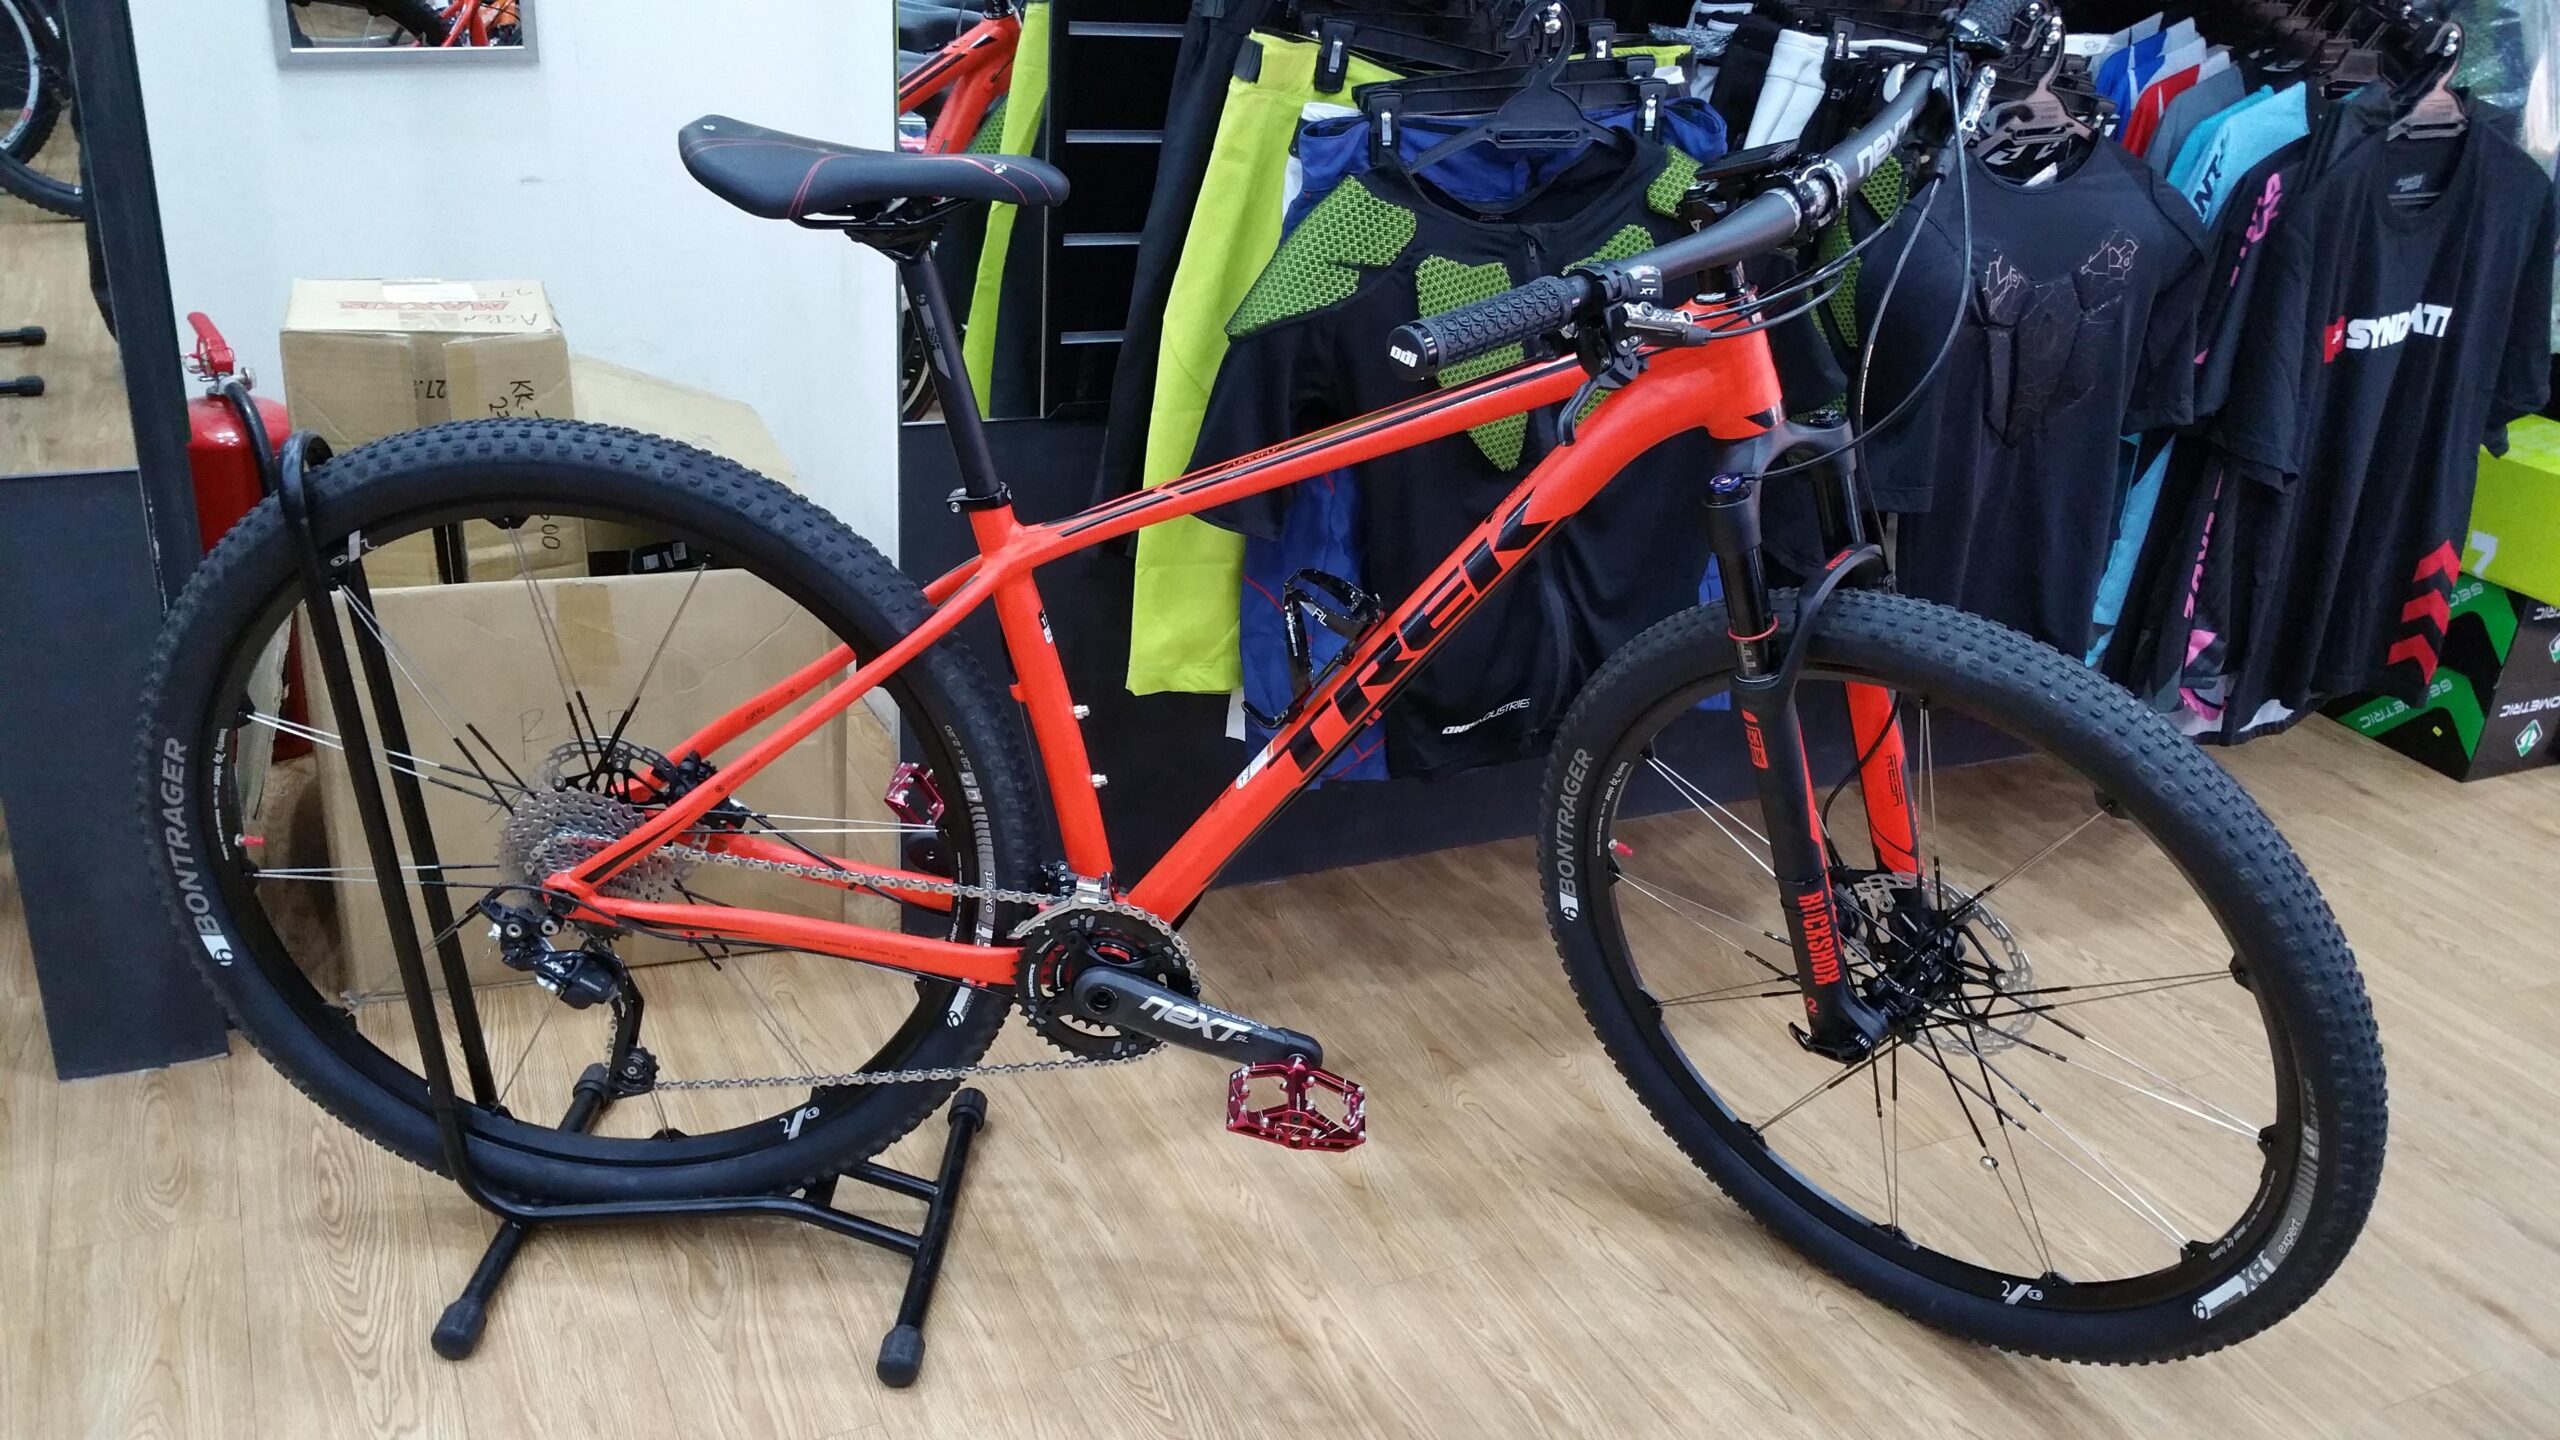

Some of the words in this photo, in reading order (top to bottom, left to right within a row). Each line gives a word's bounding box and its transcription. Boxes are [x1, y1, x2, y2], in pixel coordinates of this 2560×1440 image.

[340, 300, 513, 311] MAXXIS
[1390, 345, 1418, 368] odi
[1267, 486, 1553, 773] TREK
[1311, 607, 1327, 627] RL
[160, 736, 223, 936] BONTRAGER
[1556, 748, 1594, 897] BONTRAGER
[2277, 1217, 2302, 1255] expert
